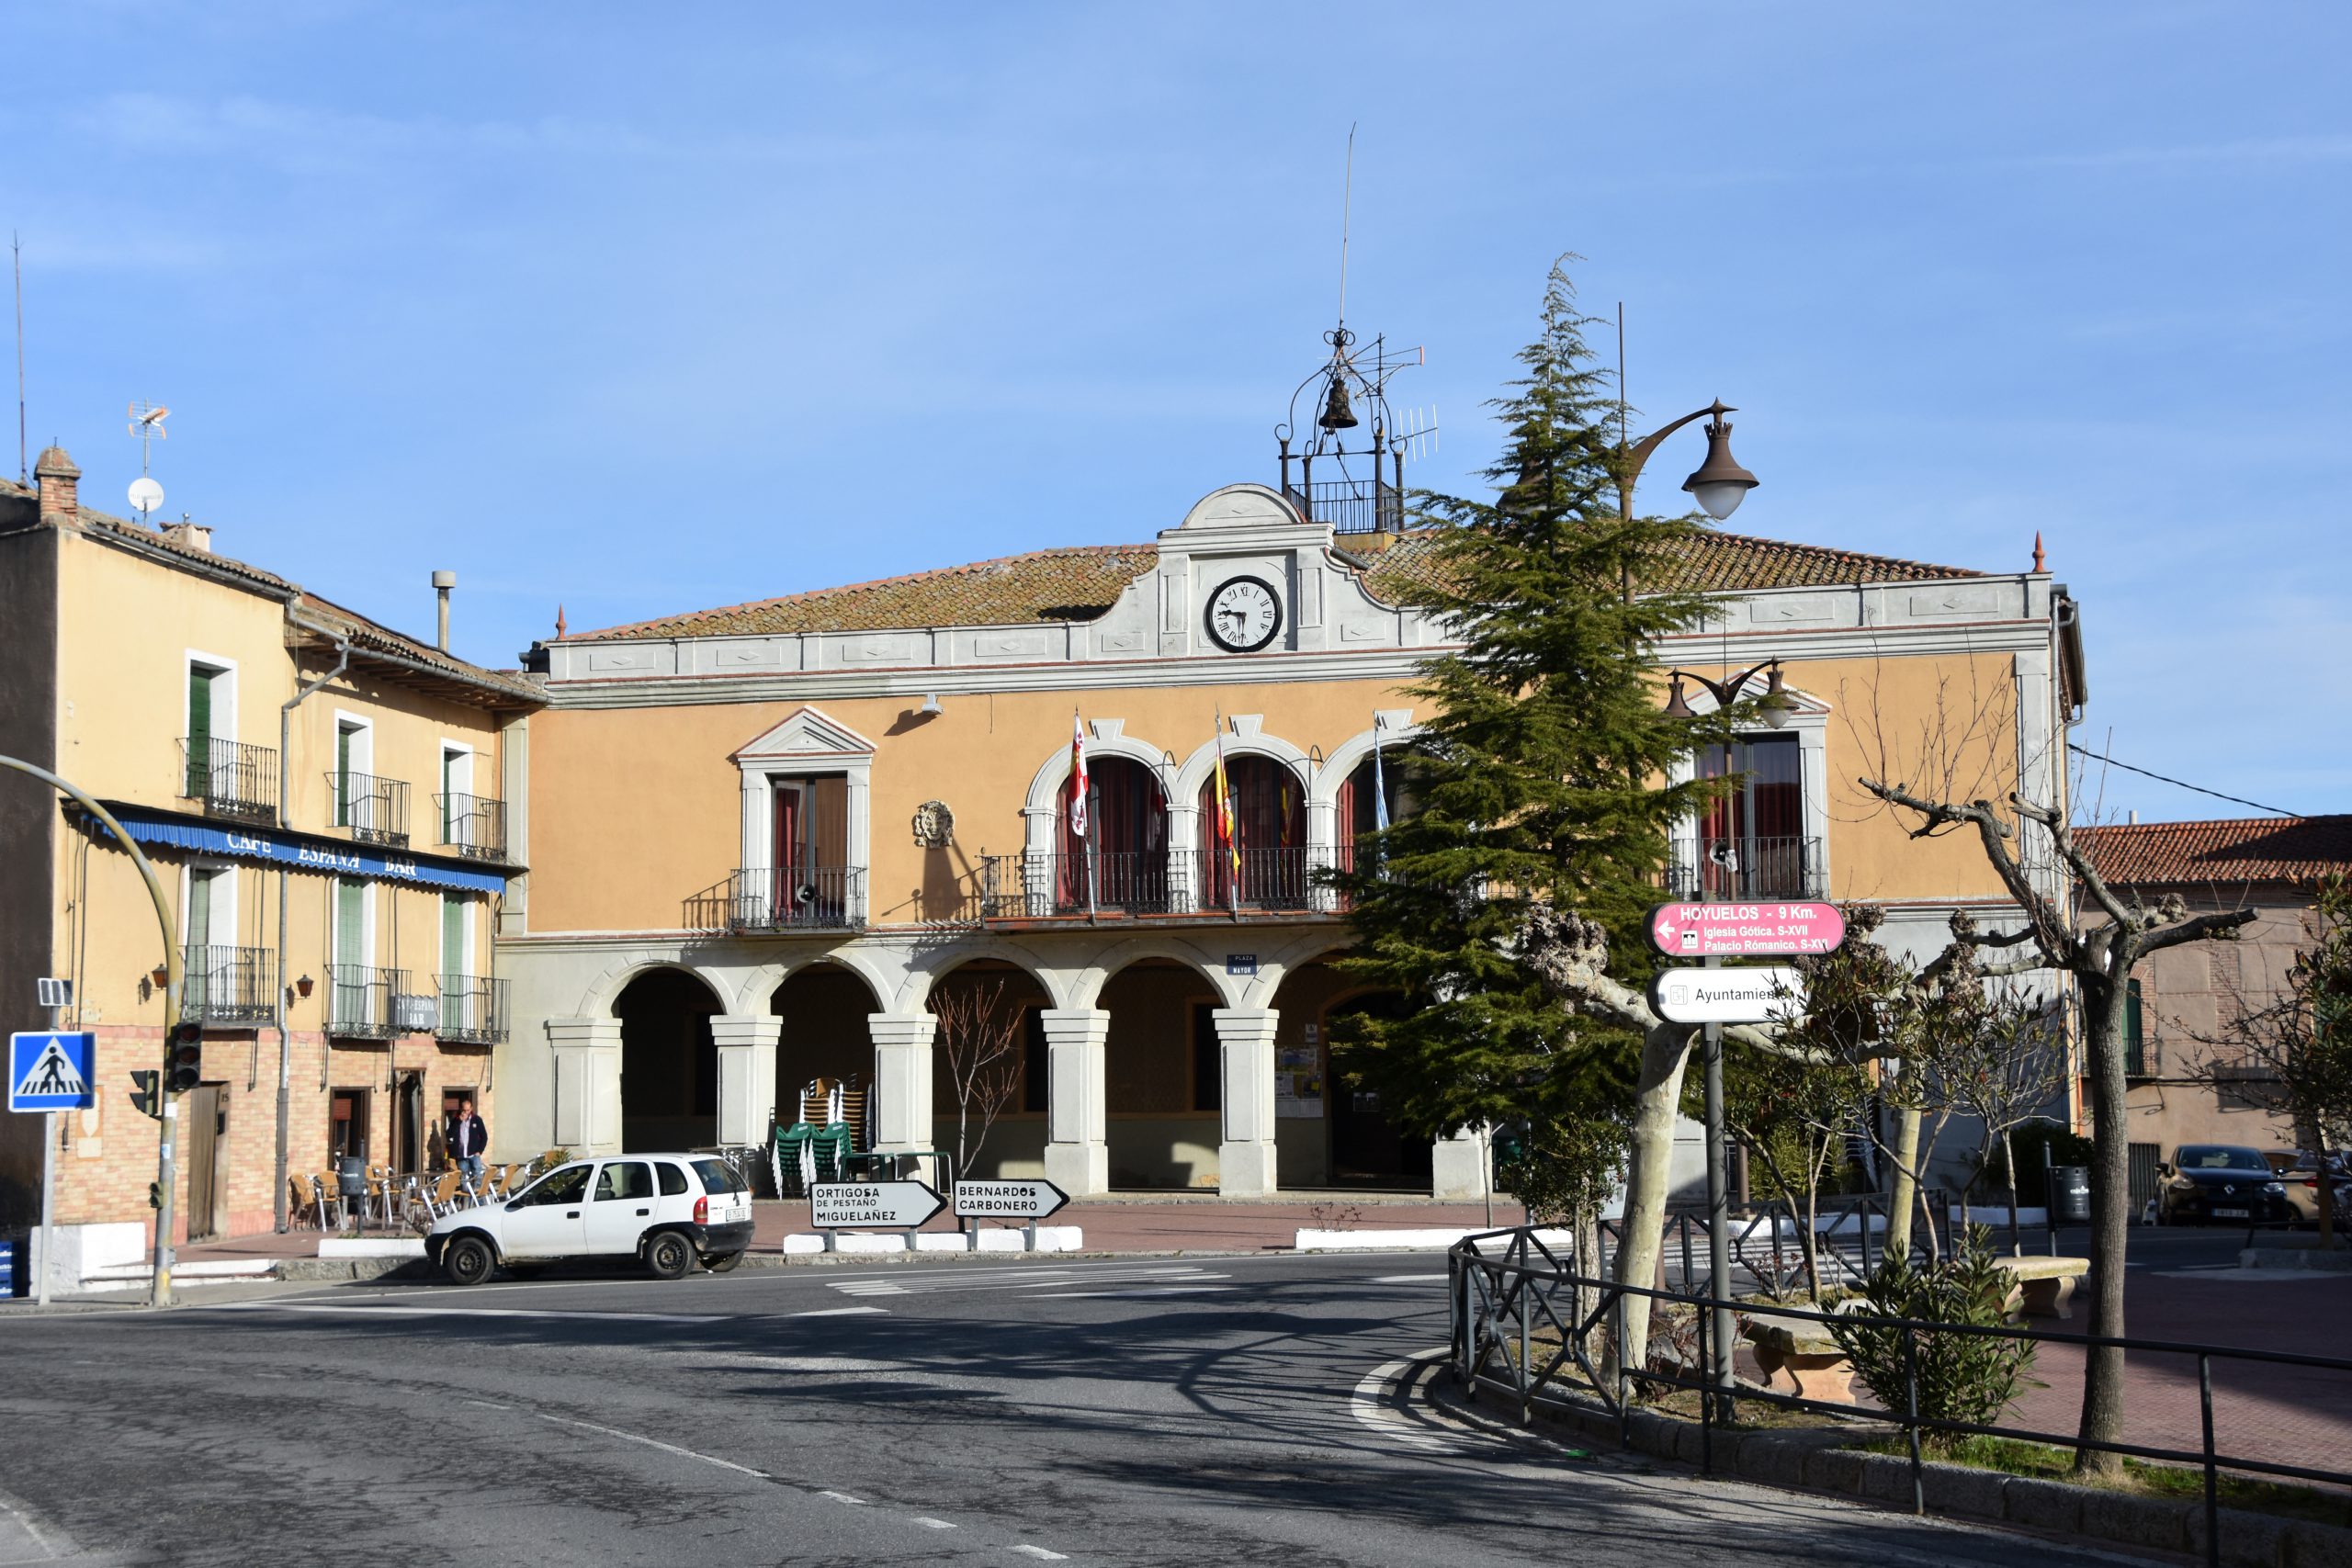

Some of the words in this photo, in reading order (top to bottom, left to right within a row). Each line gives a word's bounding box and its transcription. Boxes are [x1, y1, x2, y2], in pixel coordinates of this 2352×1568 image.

[384, 854, 416, 876] BAR
[1680, 906, 1759, 921] HOYUELOS
[1779, 906, 1787, 919] 9
[1791, 906, 1817, 919] Km.
[1703, 926, 1736, 940] Iglesia
[1739, 925, 1775, 937] Gótica.
[1777, 924, 1808, 936] S-XVII
[1704, 940, 1742, 952] Palacio
[1744, 939, 1798, 952] Rómanico.
[1800, 938, 1828, 950] S-XVI
[1695, 987, 1787, 1003] Ayuntamien
[816, 1188, 880, 1199] ORTIGOSA
[959, 1186, 1036, 1197] BERNARDOS
[833, 1198, 876, 1207] PESTAÑO
[959, 1200, 1037, 1211] CARBONERO
[817, 1209, 897, 1222] MIGUELAÑEZ
